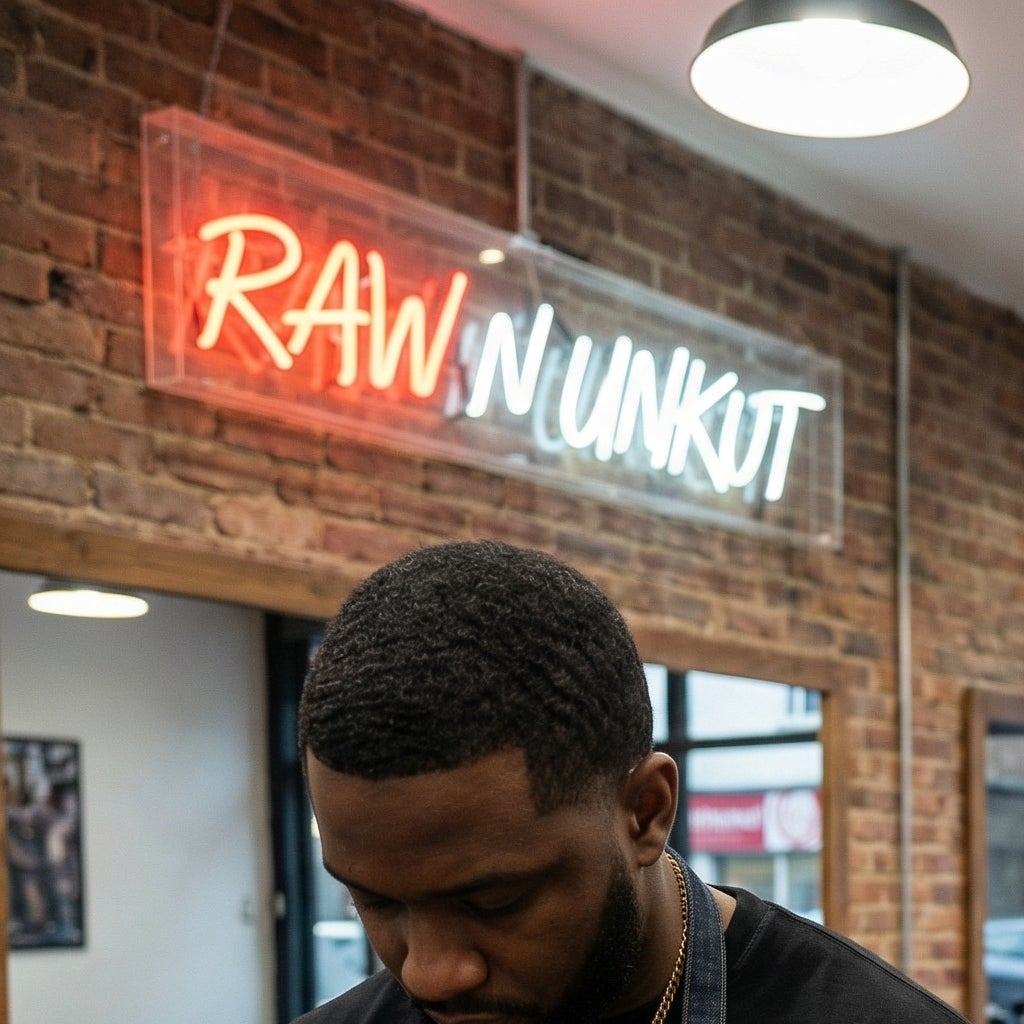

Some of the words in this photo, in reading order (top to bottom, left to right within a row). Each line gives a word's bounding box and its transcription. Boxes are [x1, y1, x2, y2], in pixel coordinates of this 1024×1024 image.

[198, 213, 468, 397] RAW
[465, 304, 554, 418] N
[559, 335, 826, 501] UNKUT
